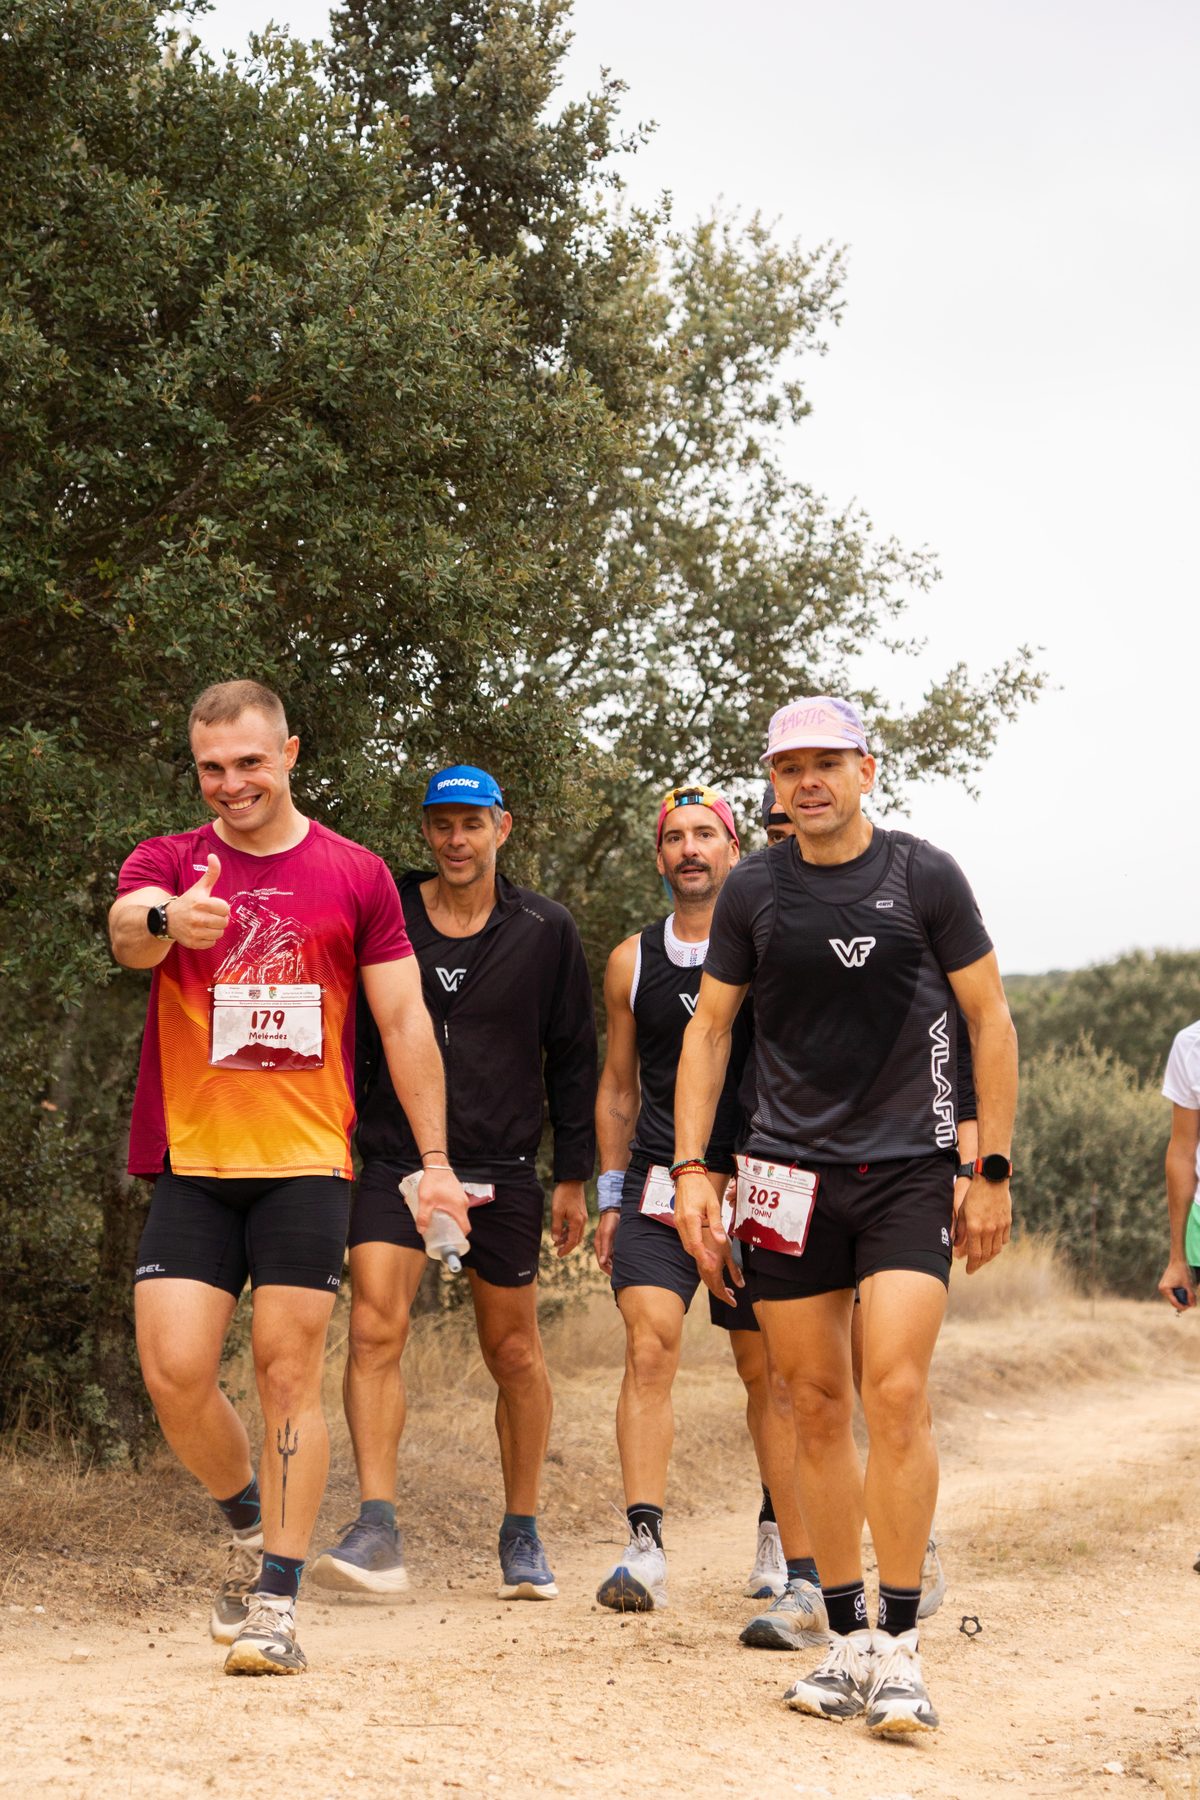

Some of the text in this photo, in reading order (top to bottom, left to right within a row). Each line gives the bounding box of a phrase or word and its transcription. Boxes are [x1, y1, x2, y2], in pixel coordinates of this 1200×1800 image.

[780, 708, 826, 735] LACTIC
[437, 778, 480, 791] BROOKS
[828, 936, 876, 968] VF
[678, 992, 700, 1017] V
[251, 1010, 285, 1030] 179
[248, 1032, 287, 1040] Meléndez
[748, 1185, 780, 1209] 203
